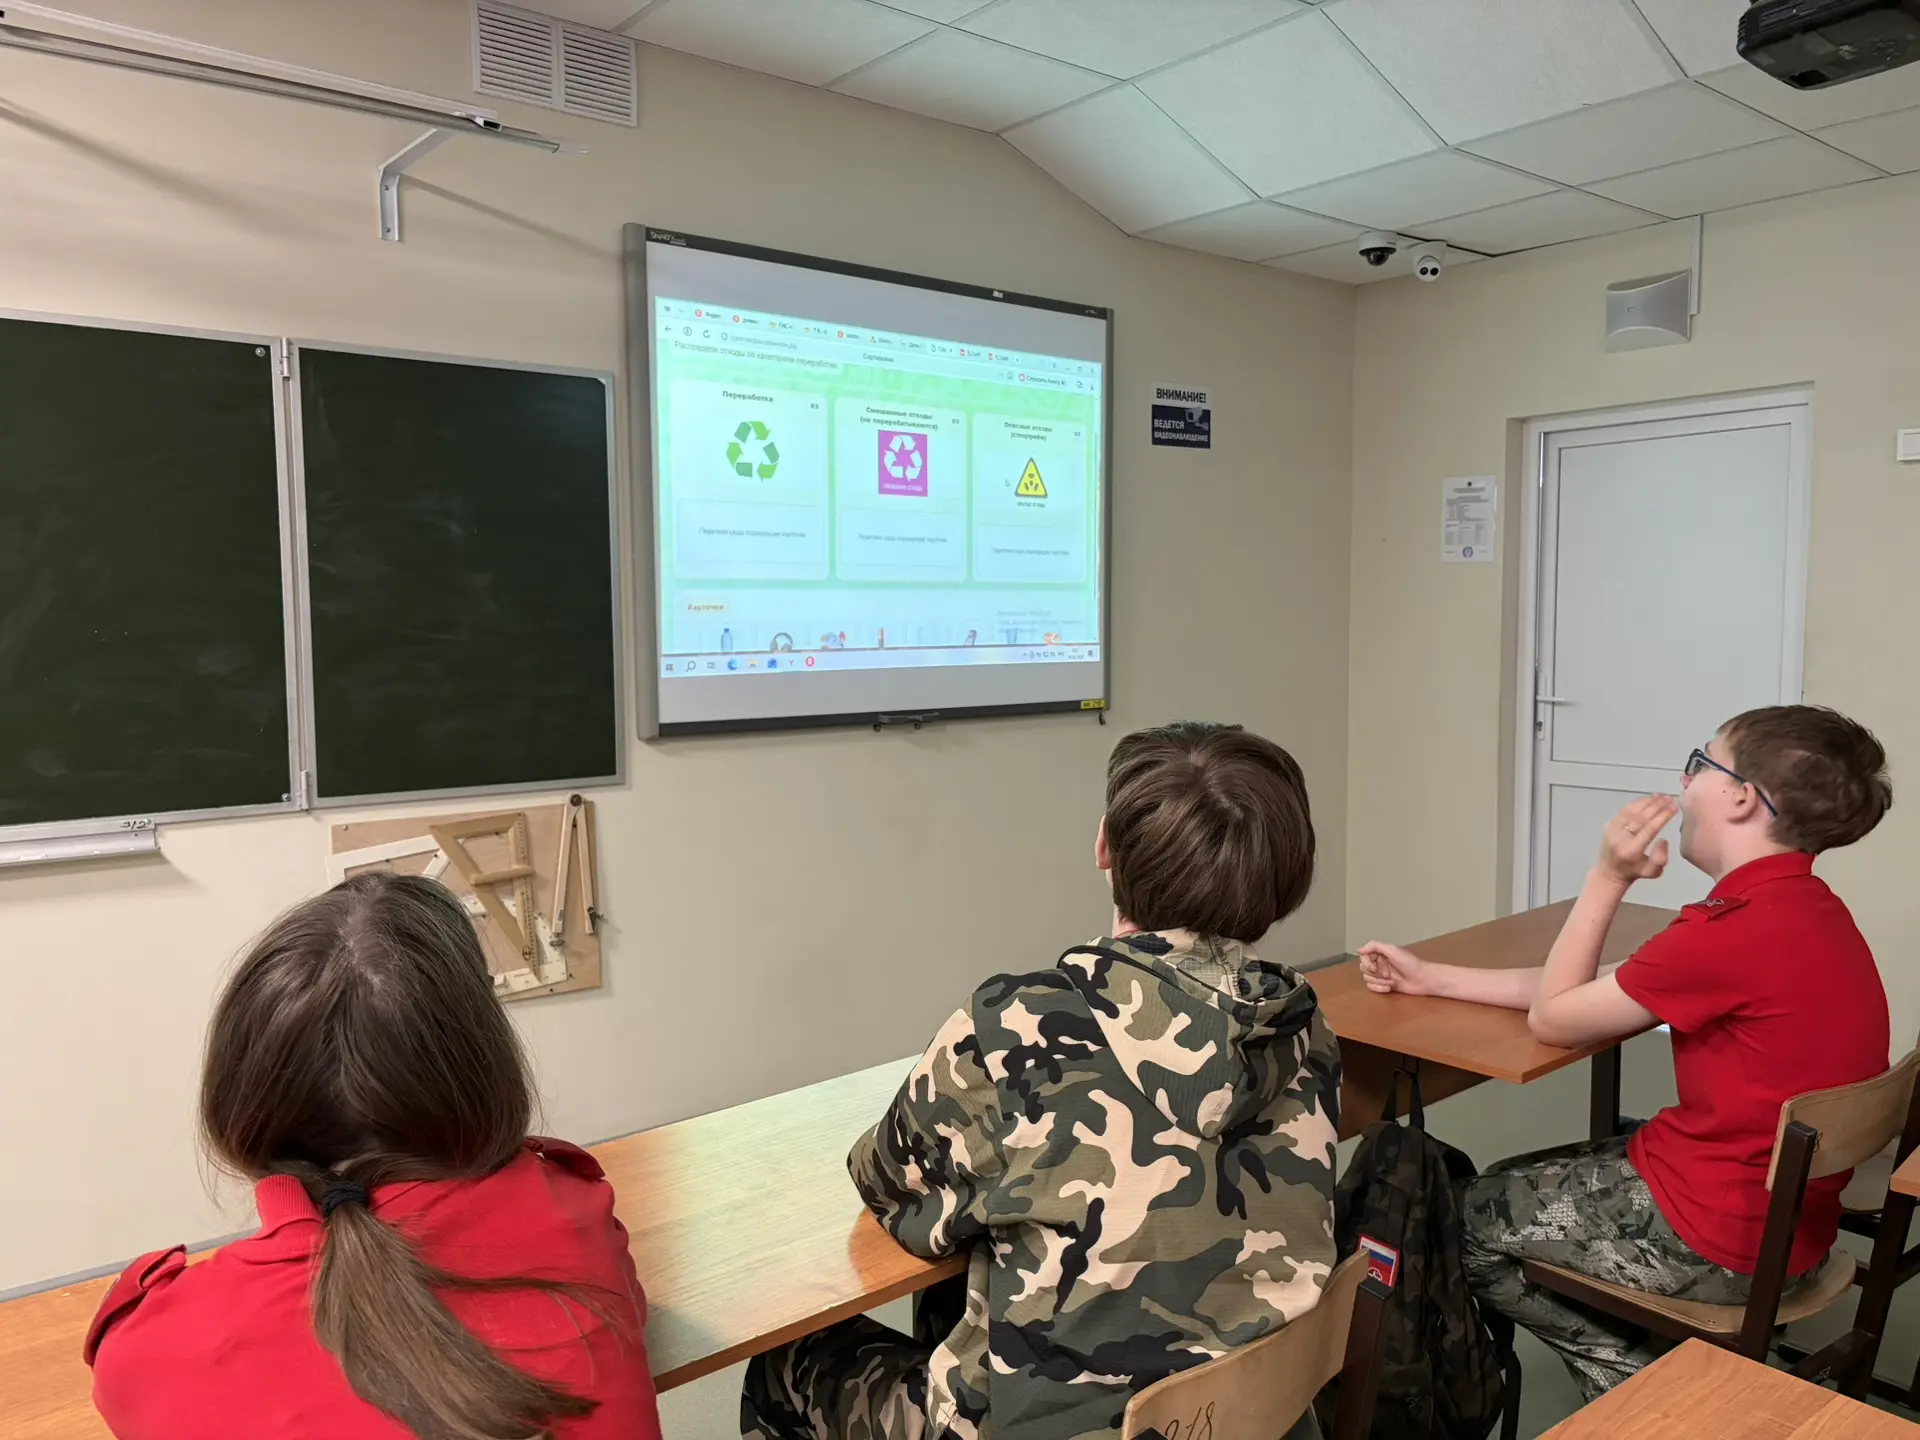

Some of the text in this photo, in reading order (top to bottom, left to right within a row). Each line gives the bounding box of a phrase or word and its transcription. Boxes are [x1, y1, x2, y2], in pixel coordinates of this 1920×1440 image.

[719, 347, 746, 358] отходы
[746, 351, 756, 360] по
[722, 390, 774, 403] Переработка
[1156, 388, 1207, 403] ВНИМАНИЕ!
[865, 406, 933, 420] Смешанные отходы
[872, 418, 938, 431] перерабатываются)
[1154, 419, 1185, 430] ВЕДЕТСЯ
[1153, 431, 1209, 442] ВИДЕОНАБЛЮДЕНИЕ
[687, 603, 724, 613] Карточки
